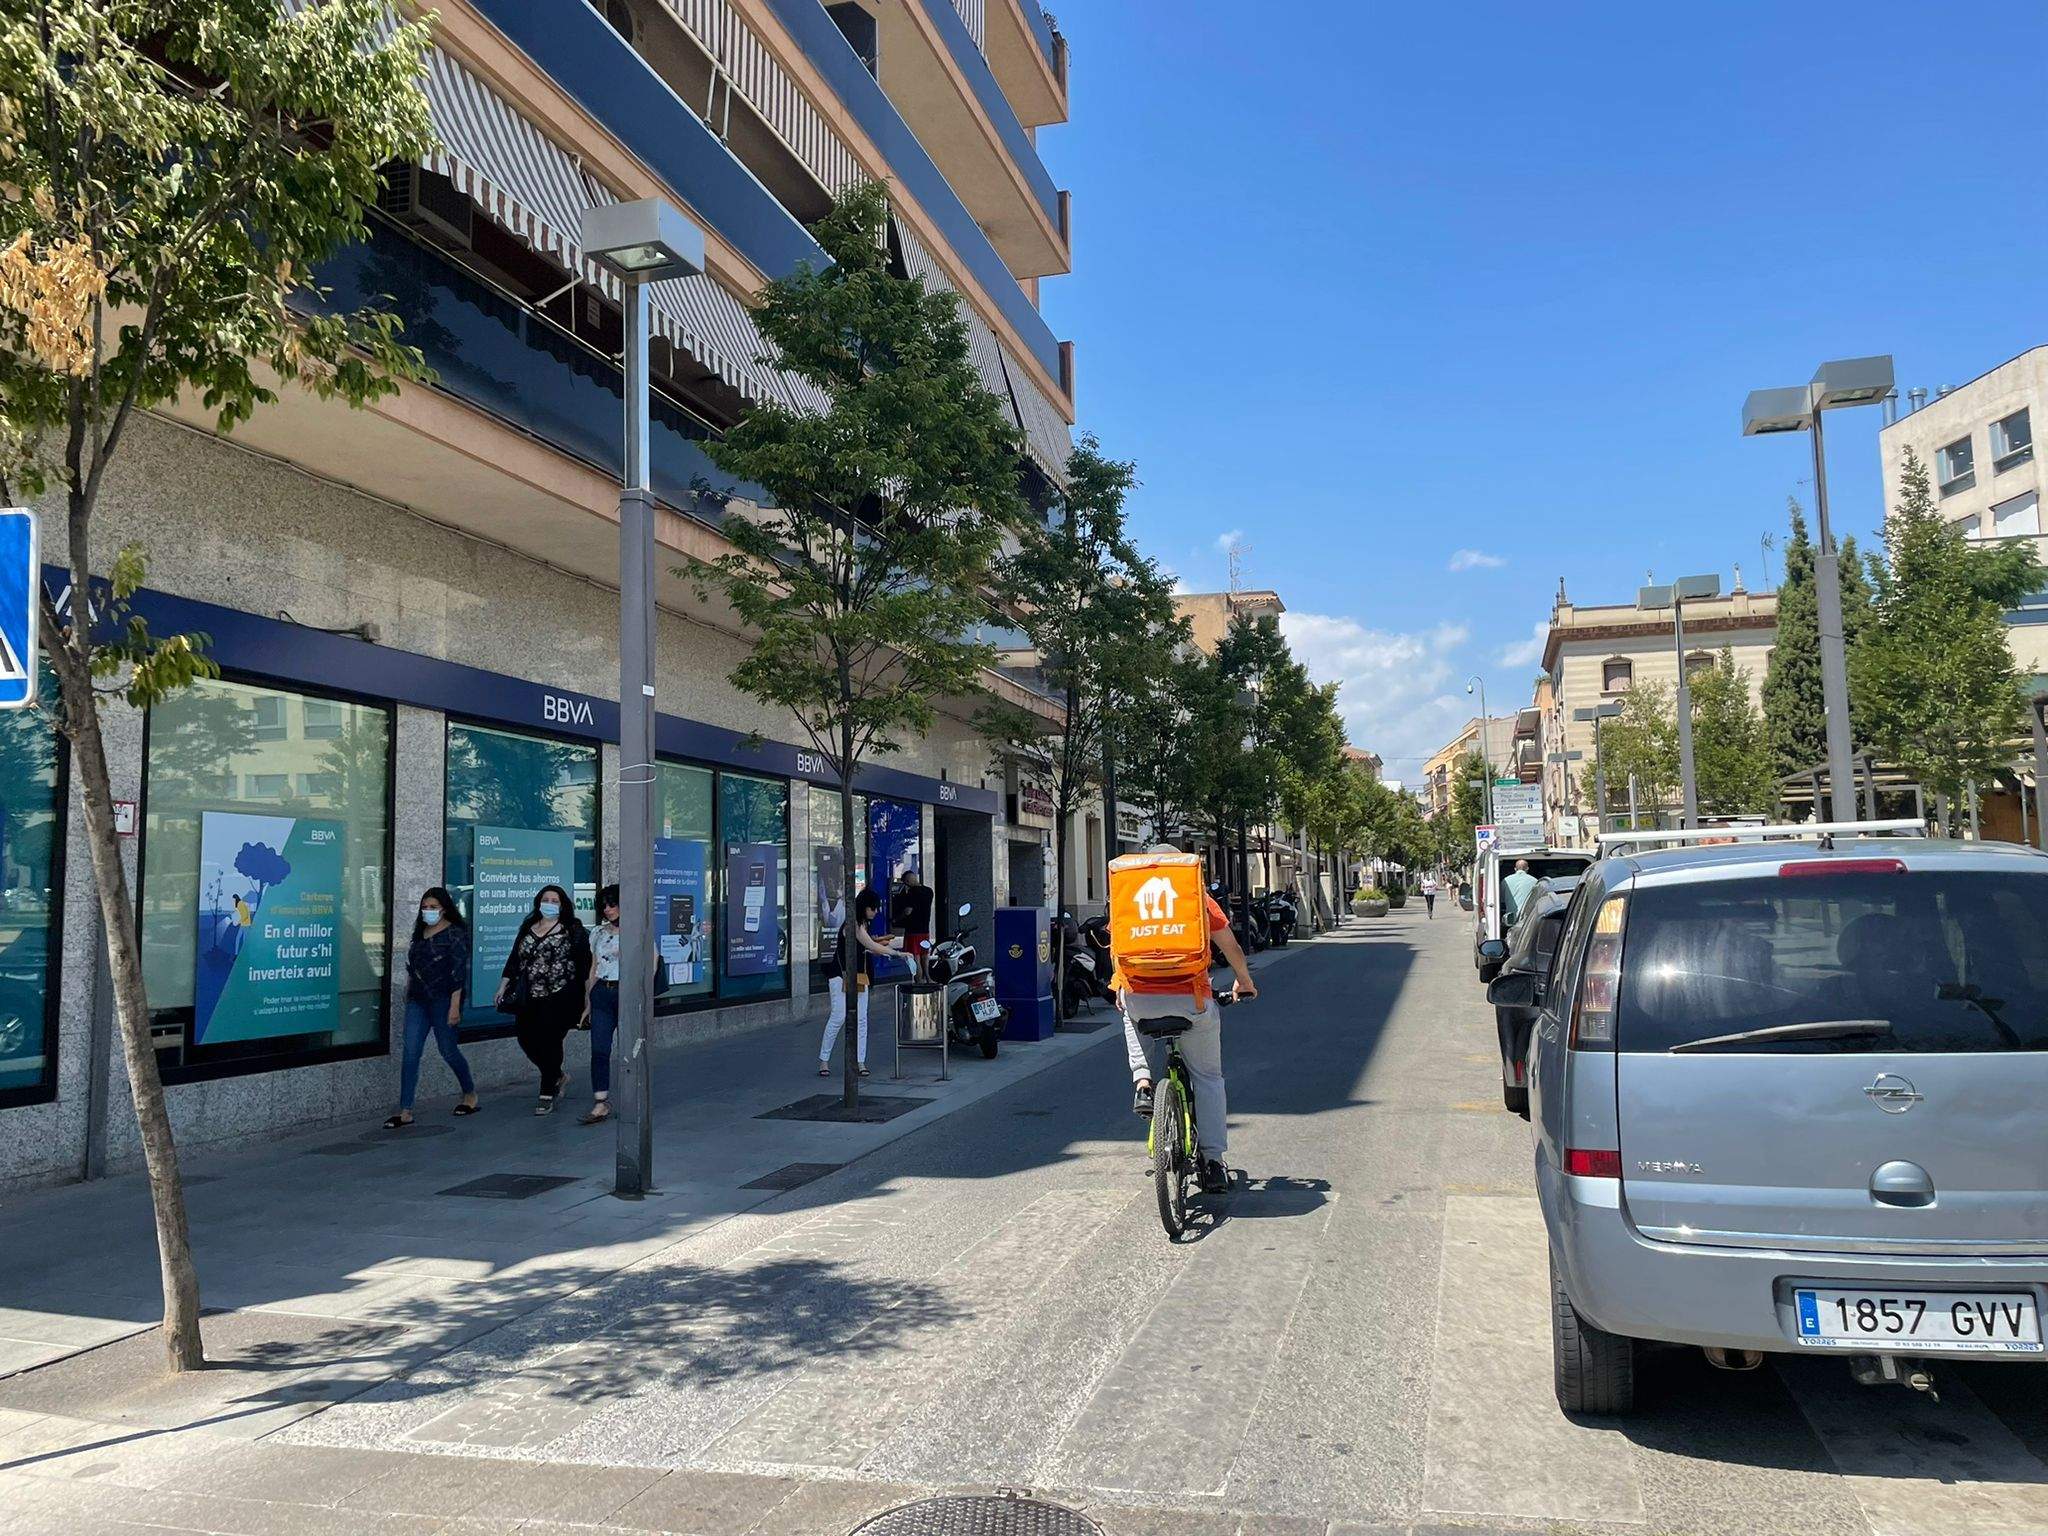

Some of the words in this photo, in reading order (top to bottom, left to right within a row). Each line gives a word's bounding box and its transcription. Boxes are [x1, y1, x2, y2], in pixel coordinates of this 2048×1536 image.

[544, 695, 594, 725] BBVA
[797, 753, 825, 774] BBVA
[939, 785, 957, 800] BBVA
[311, 830, 336, 841] BBVA
[480, 835, 500, 847] BBVA
[480, 872, 518, 883] Convierte
[519, 873, 532, 883] tus
[533, 874, 560, 884] ahorros
[480, 890, 490, 898] en
[491, 890, 506, 898] una
[508, 888, 538, 899] inversió
[479, 902, 516, 915] adaptada
[524, 903, 530, 913] ti
[264, 924, 280, 938] En
[284, 924, 295, 938] el
[298, 924, 333, 938] millor
[1130, 925, 1159, 940] JUST
[1162, 924, 1186, 935] EAT
[276, 945, 309, 959] futur
[248, 966, 304, 981] inverteix
[307, 963, 332, 978] avui
[1806, 1318, 1814, 1328] E
[1836, 1297, 1926, 1335] 1857
[1951, 1301, 2023, 1338] GVV
